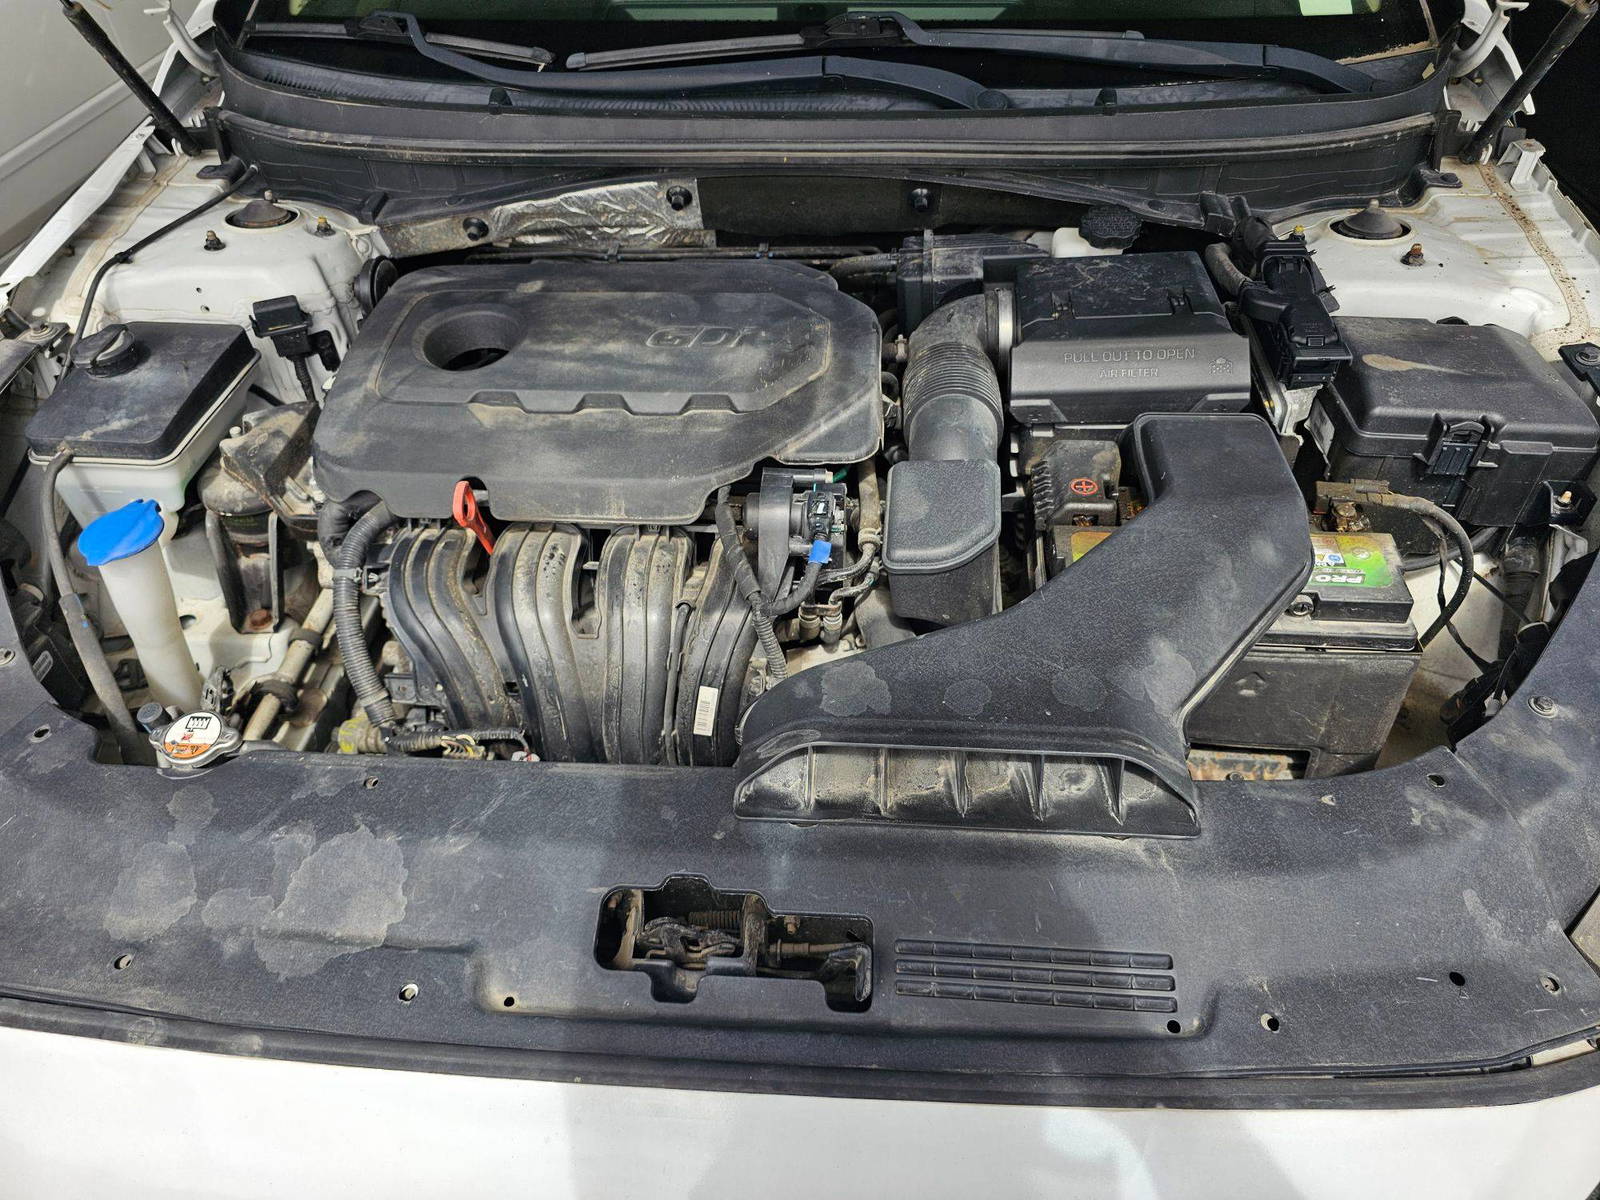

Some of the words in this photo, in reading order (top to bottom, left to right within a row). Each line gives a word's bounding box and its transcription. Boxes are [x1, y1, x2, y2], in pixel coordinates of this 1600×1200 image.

[1062, 352, 1098, 363] PULL
[1102, 350, 1130, 362] OUT
[1134, 349, 1153, 361] TO
[1156, 348, 1195, 361] OPEN
[1100, 367, 1119, 378] AIR
[1122, 367, 1159, 378] FILTER
[1314, 574, 1363, 584] PRO
